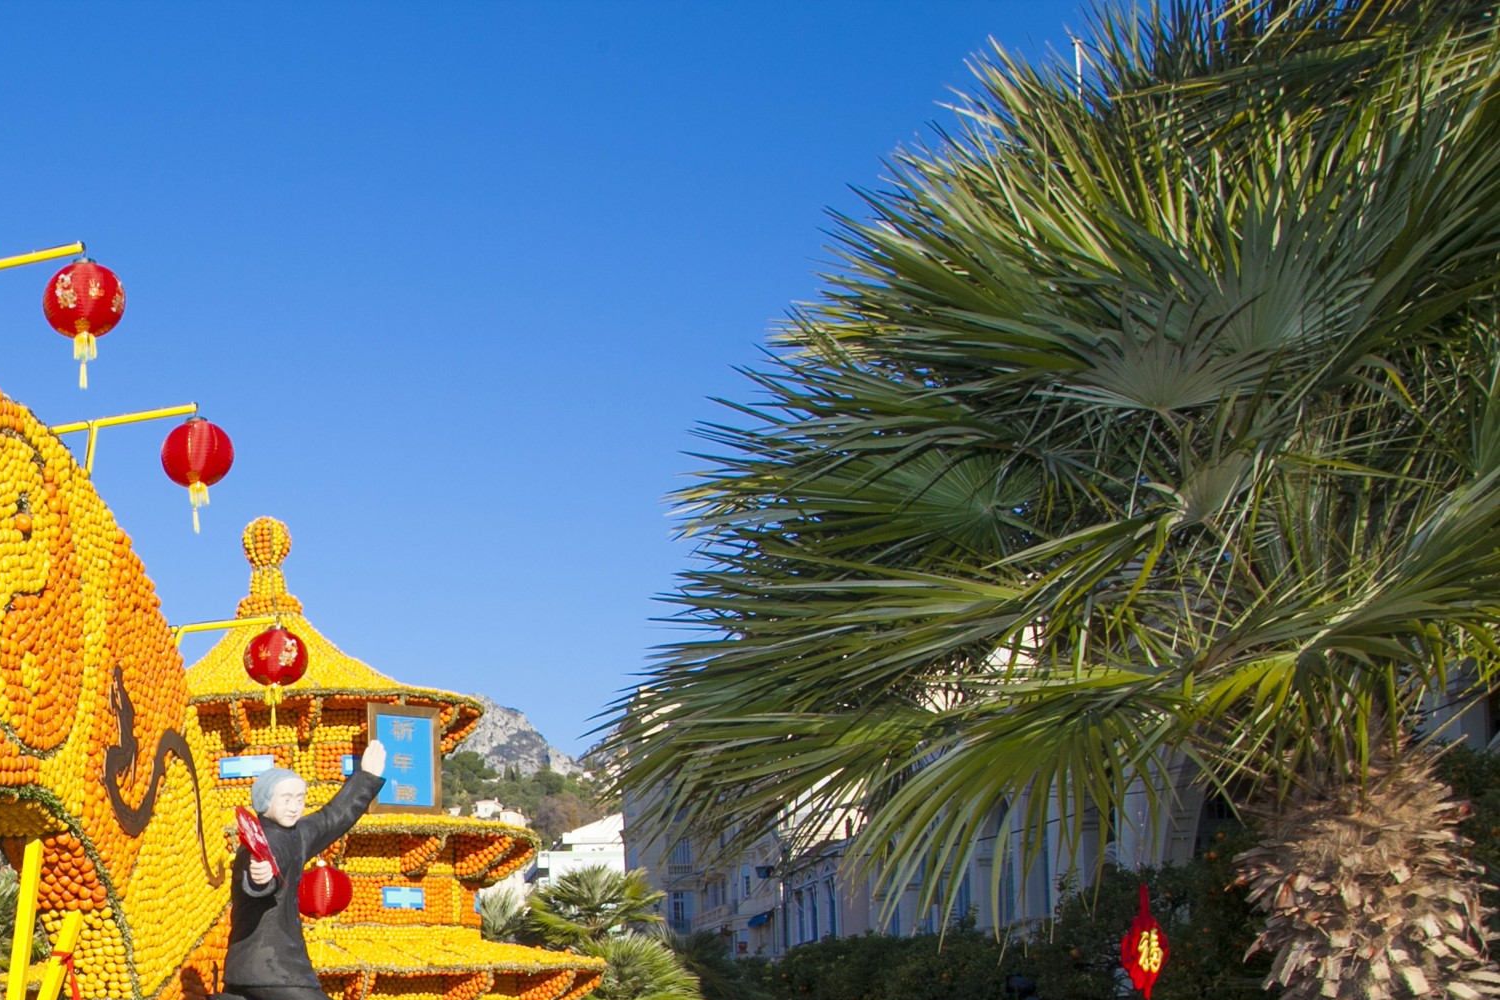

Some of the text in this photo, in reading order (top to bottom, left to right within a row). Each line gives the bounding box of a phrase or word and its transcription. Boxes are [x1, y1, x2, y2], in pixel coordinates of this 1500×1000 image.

[391, 719, 417, 802] 祈年殿
[1137, 928, 1164, 973] 福
